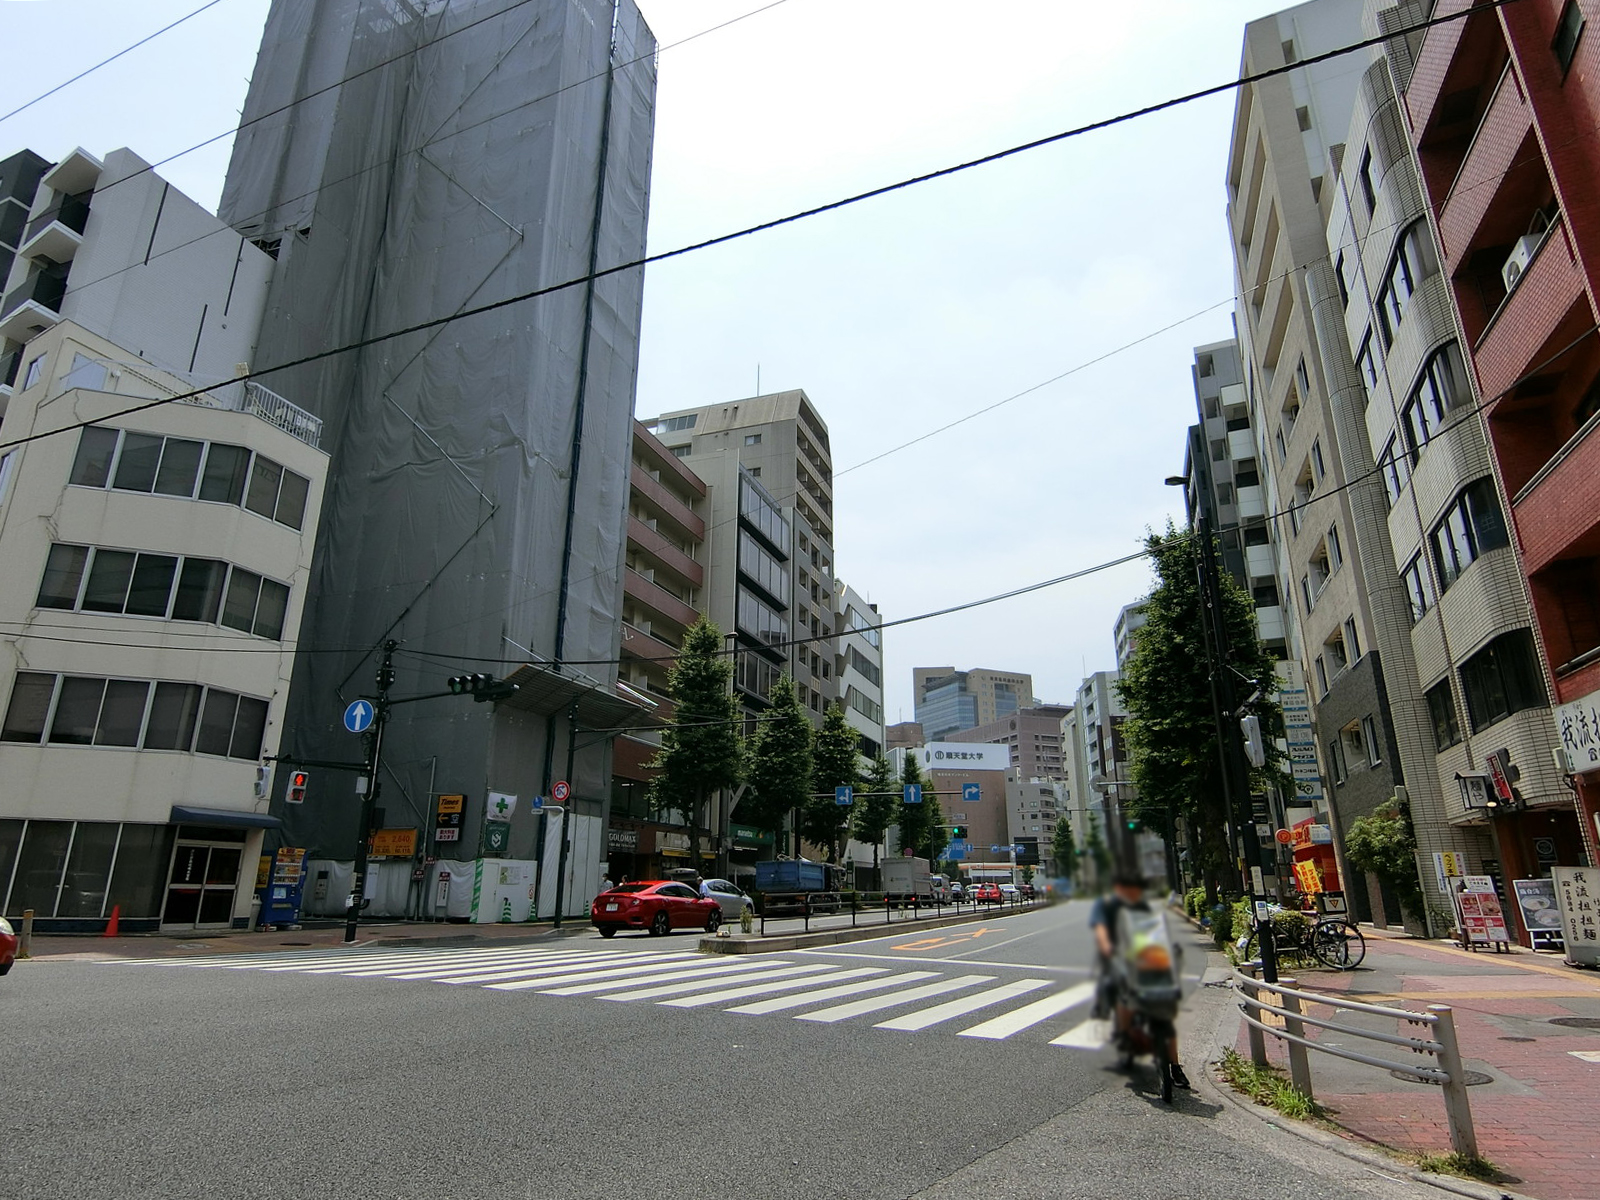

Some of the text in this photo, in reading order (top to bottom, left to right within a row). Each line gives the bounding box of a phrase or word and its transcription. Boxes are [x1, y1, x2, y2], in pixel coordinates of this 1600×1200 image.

[945, 751, 984, 760] 順天堂大学
[441, 798, 460, 806] Times
